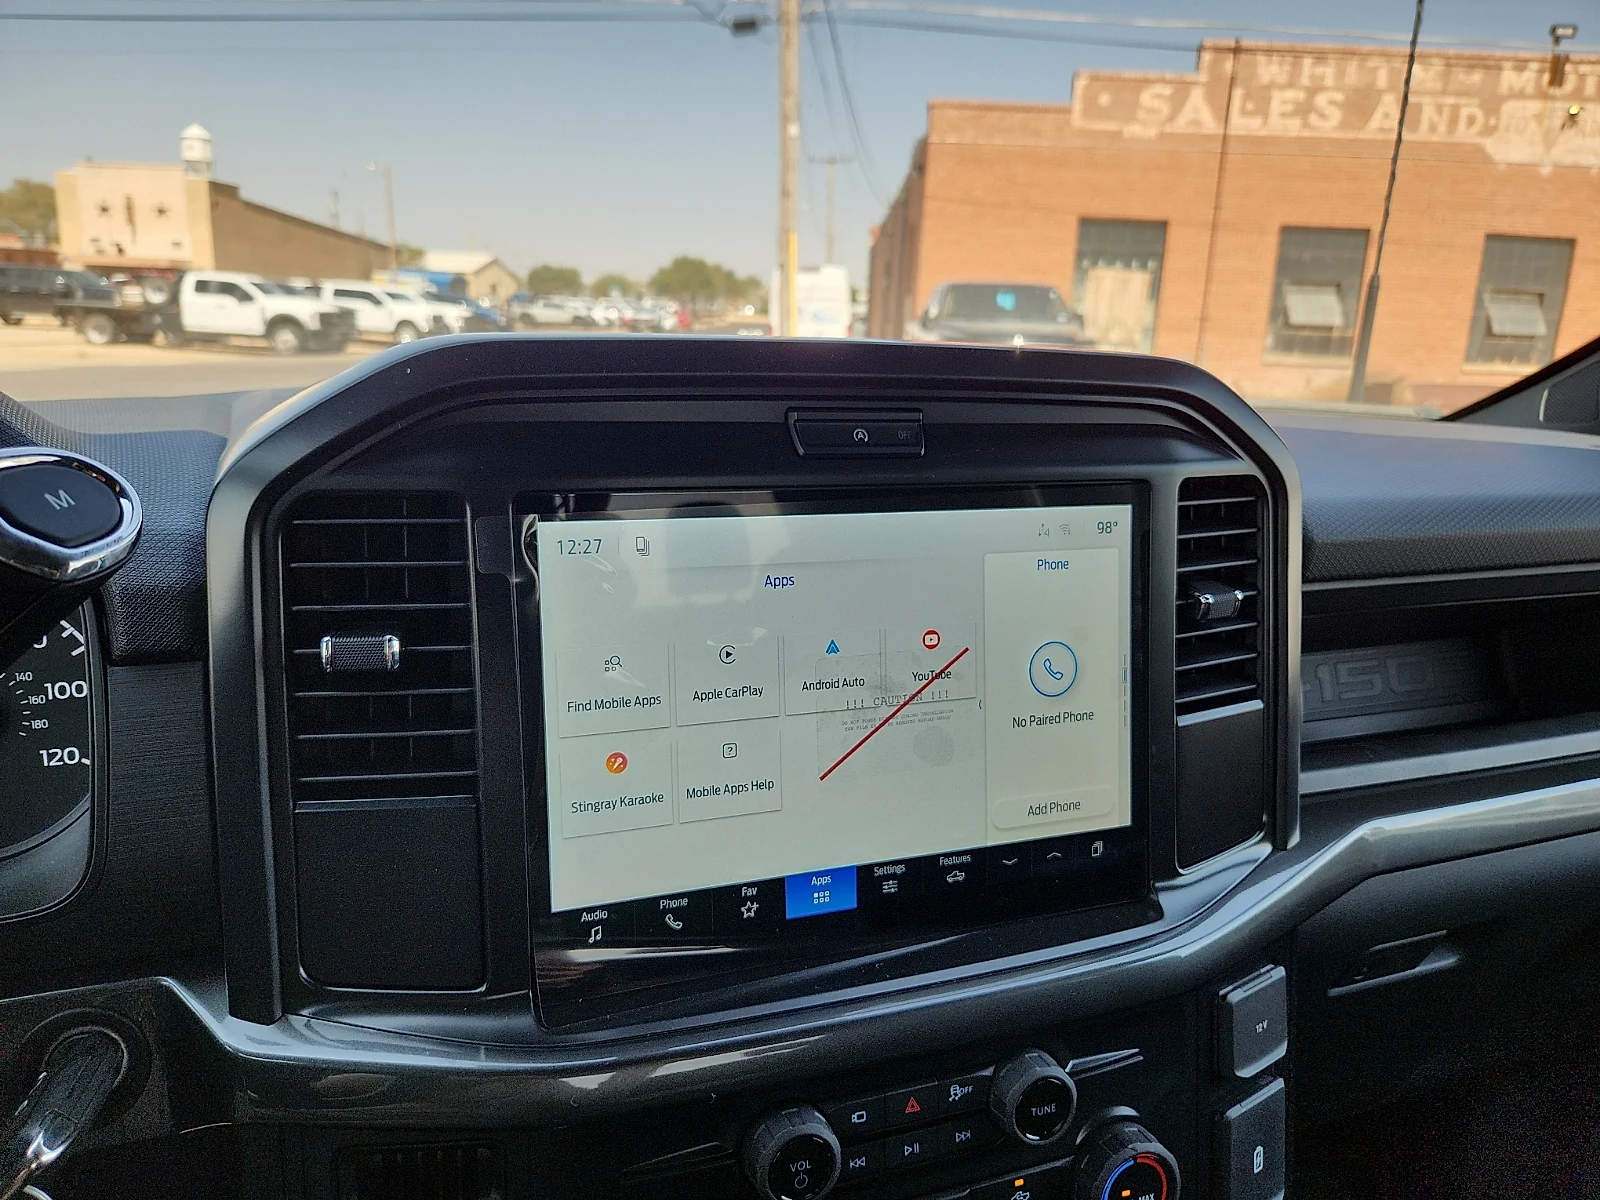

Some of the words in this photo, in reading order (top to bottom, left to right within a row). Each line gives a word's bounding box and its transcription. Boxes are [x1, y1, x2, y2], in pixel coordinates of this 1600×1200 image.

[1136, 84, 1346, 131] SALES
[1366, 92, 1484, 137] AND
[45, 489, 75, 509] M
[556, 538, 602, 555] 12:27
[1037, 558, 1069, 571] Phone
[764, 574, 795, 589] Apps
[15, 672, 33, 681] 140
[911, 670, 952, 682] YouTube
[44, 681, 87, 700] 100
[801, 679, 840, 692] Android
[841, 677, 865, 688] Auto
[28, 695, 46, 704] 160
[692, 688, 723, 702] Apple
[725, 686, 764, 699] CarPlay
[567, 700, 592, 712] Find
[594, 698, 632, 710] Mobile
[633, 695, 662, 709] Apps
[30, 719, 49, 729] 180
[1012, 717, 1027, 728] No
[1029, 712, 1061, 726] Paired
[1062, 711, 1094, 722] Phone
[39, 747, 80, 767] 120
[686, 786, 721, 799] Mobile
[723, 783, 749, 796] Apps
[750, 779, 775, 792] Help
[571, 799, 618, 813] Stingray
[619, 793, 664, 807] Karaoke
[1027, 805, 1048, 817] Add
[1049, 801, 1081, 813] Phone
[939, 853, 971, 866] Features
[873, 863, 906, 876] Settings
[811, 874, 832, 886] Apps
[741, 886, 758, 897] Fav
[660, 897, 688, 909] Phone
[581, 909, 608, 922] Audio
[959, 1085, 974, 1096] OFF
[1031, 1103, 1056, 1116] TUNE
[790, 1160, 812, 1172] VOL
